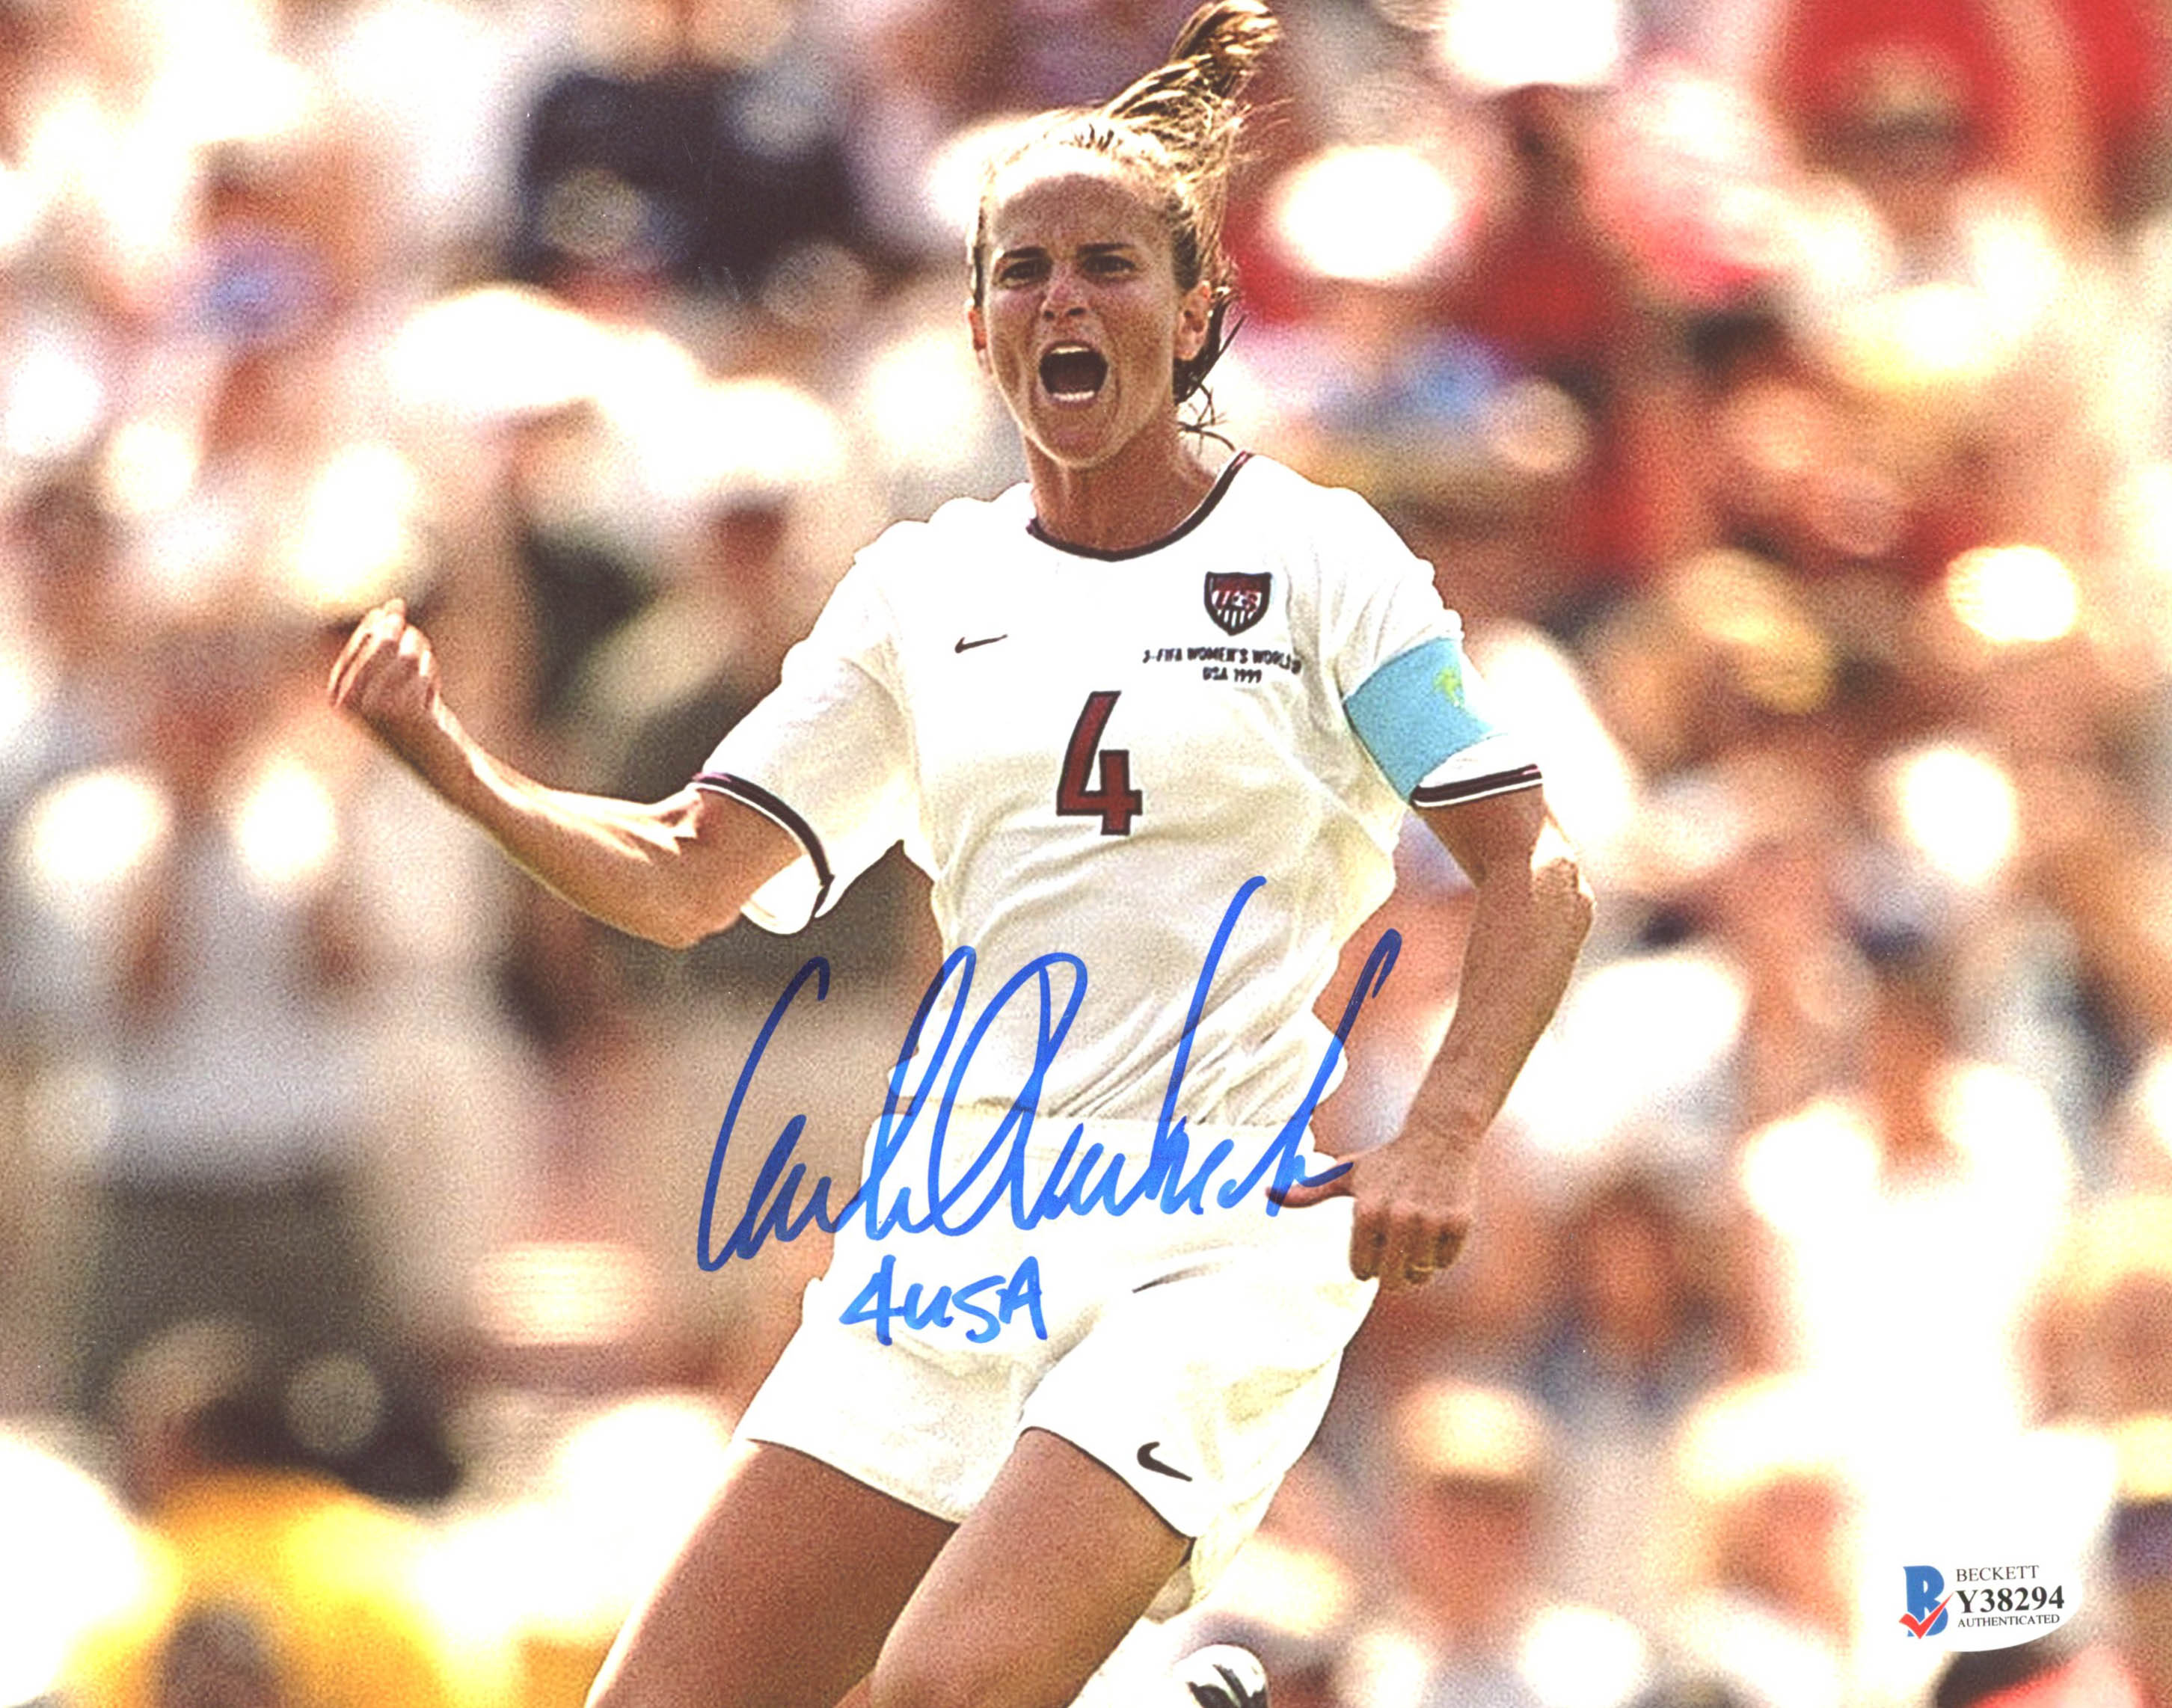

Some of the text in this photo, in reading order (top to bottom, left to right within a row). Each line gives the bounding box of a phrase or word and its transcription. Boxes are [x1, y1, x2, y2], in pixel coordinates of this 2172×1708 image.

[1188, 648, 1248, 663] WOMEN'S
[1203, 666, 1263, 683] USA 1999
[1056, 690, 1143, 836] 4
